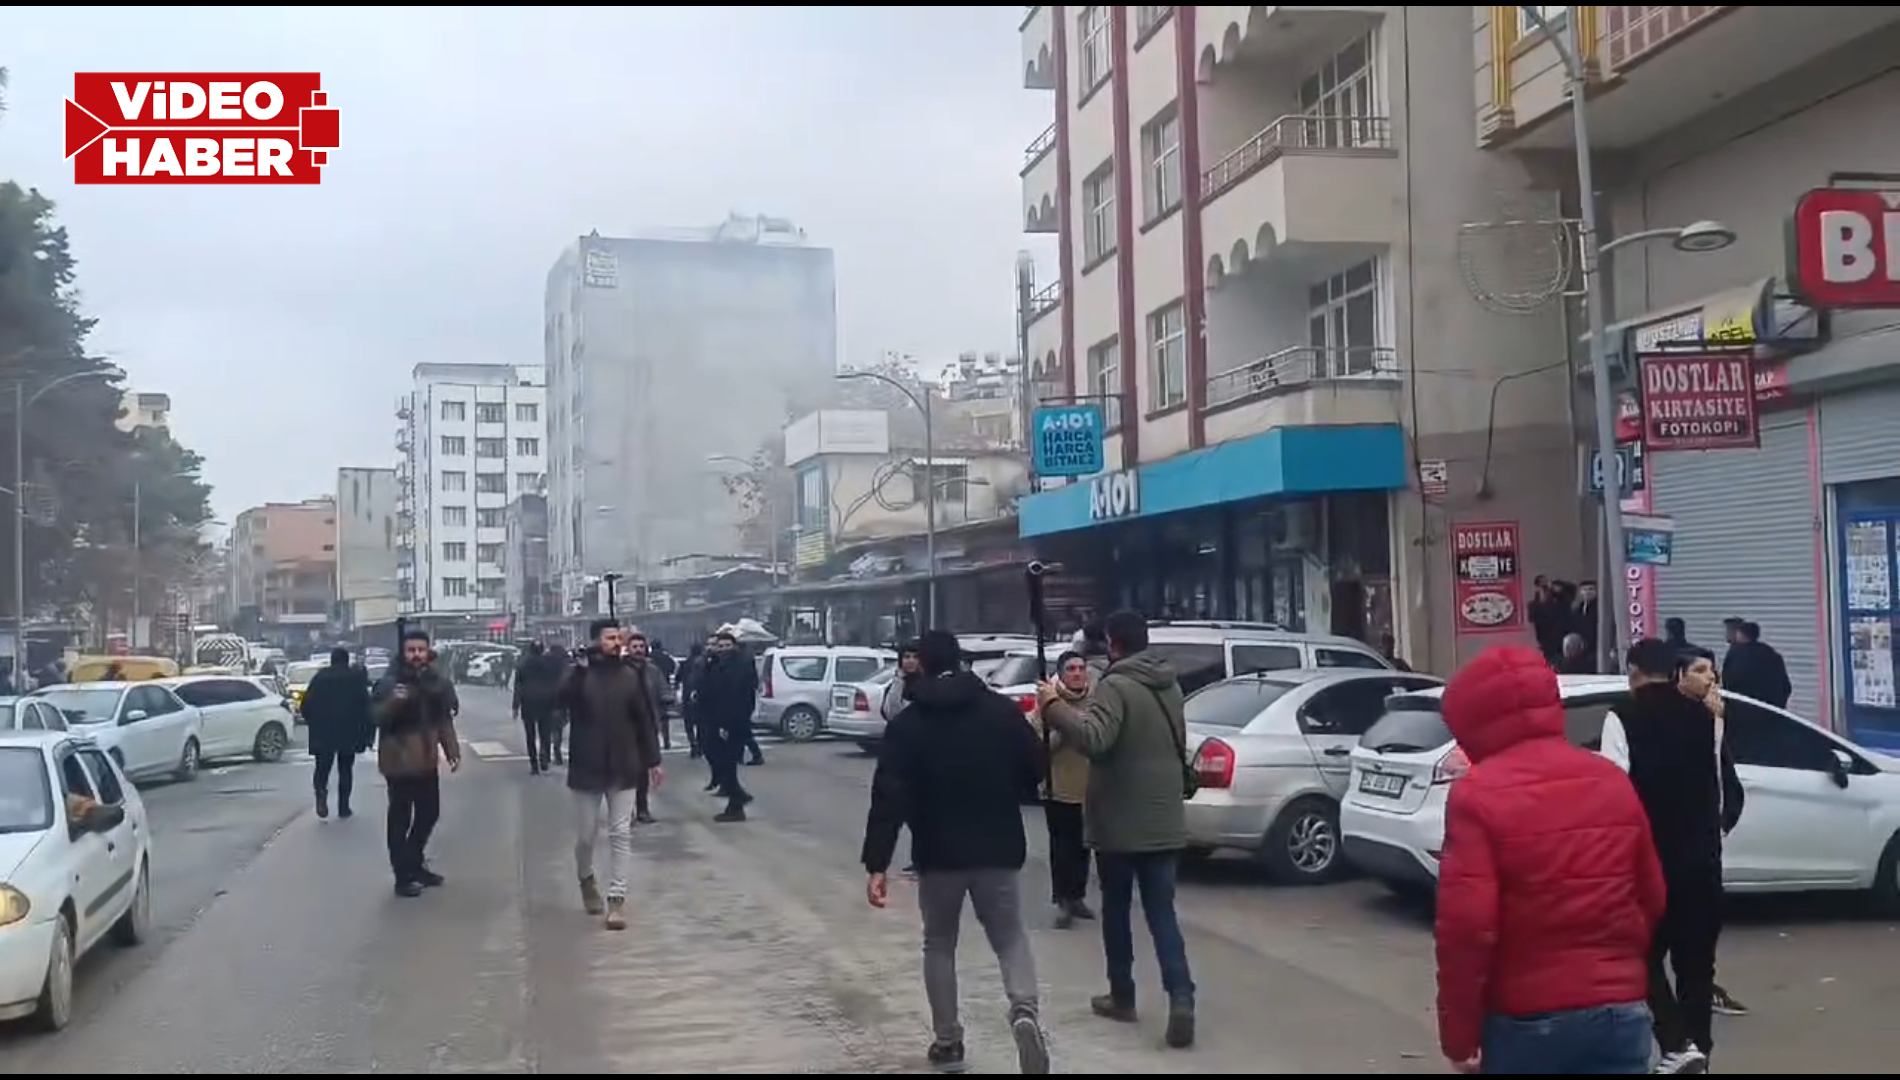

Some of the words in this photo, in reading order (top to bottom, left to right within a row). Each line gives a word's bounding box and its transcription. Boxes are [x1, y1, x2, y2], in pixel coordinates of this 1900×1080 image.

[1647, 362, 1744, 393] DOSTLAR
[1043, 431, 1093, 444] HARCA
[1043, 442, 1094, 455] HARCA
[1458, 531, 1512, 549] DOSTLAR
